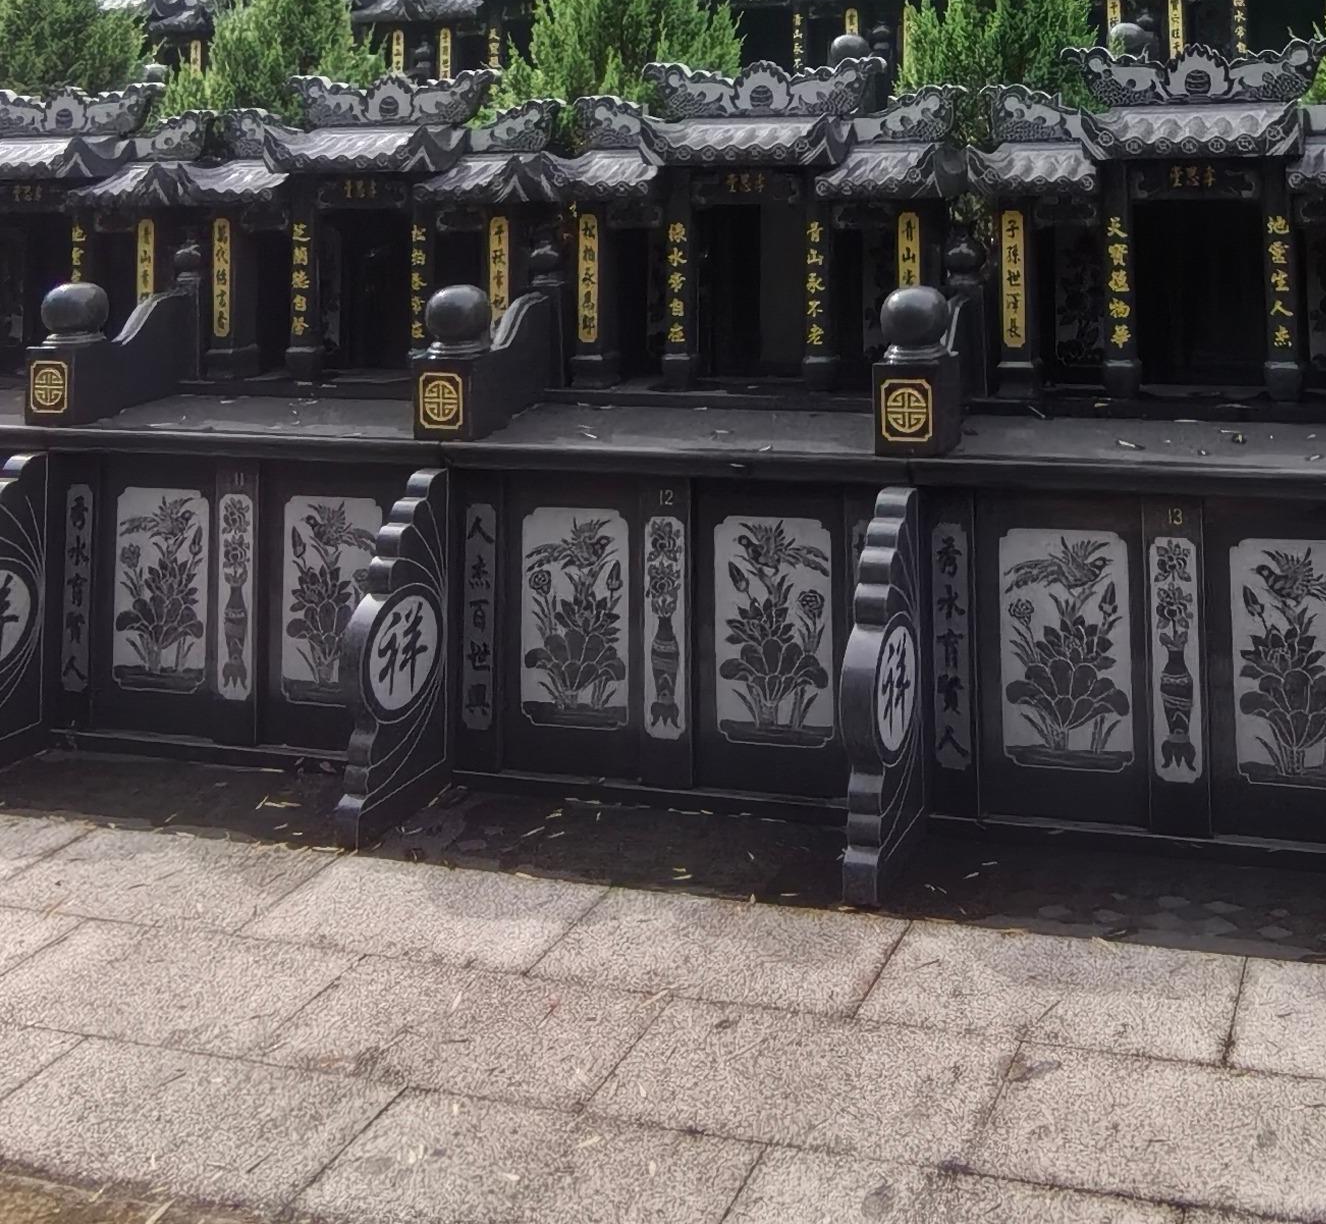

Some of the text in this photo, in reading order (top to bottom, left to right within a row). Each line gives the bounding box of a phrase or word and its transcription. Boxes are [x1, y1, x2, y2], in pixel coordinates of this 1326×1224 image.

[659, 489, 674, 506] 12
[1168, 508, 1184, 525] 13
[378, 601, 428, 696] 祥
[881, 631, 911, 737] 祥
